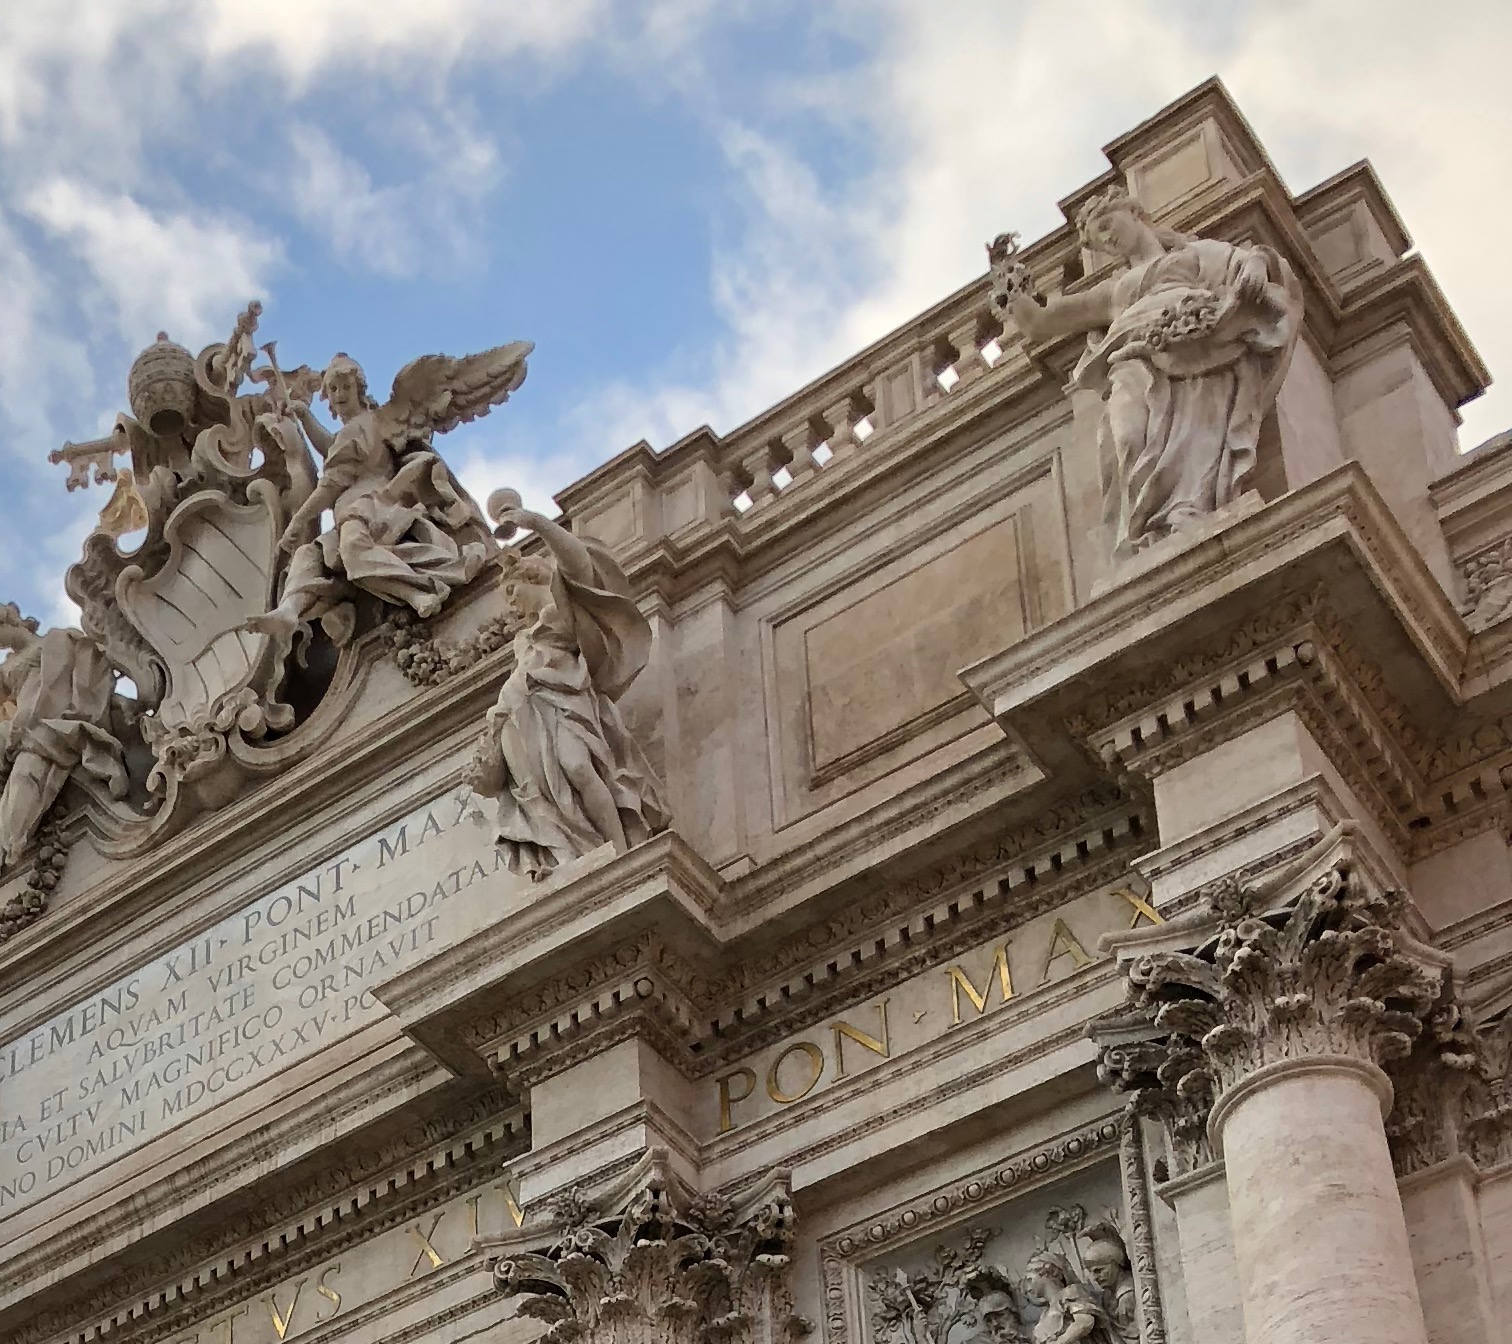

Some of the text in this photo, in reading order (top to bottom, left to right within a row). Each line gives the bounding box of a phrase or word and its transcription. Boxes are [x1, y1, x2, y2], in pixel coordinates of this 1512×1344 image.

[87, 894, 356, 1065] AQVAM VIRGINEM
[944, 883, 1166, 1029] MAX
[16, 914, 439, 1164] CVLTV MAGNIFICO ORNAVIT
[39, 1087, 69, 1122] ET
[78, 984, 255, 1100] SALVBRITATE
[46, 1110, 146, 1182] DOMINI
[405, 1179, 526, 1279] XIV
